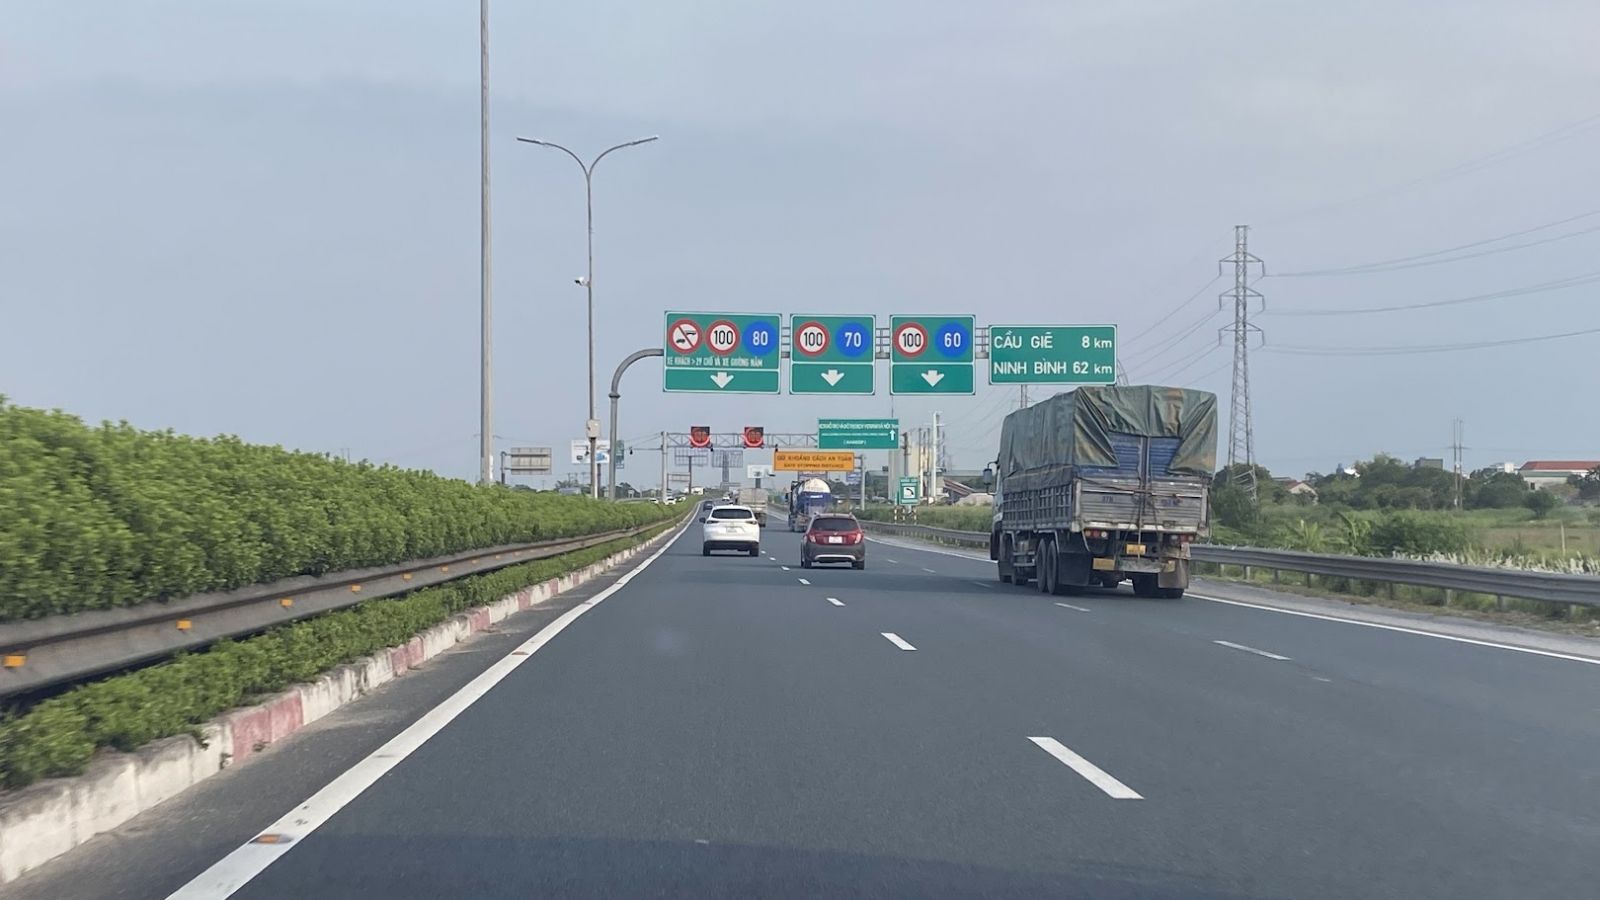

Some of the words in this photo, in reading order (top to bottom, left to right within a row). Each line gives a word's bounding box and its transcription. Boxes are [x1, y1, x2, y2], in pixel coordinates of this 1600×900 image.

[714, 330, 733, 345] 100
[752, 331, 768, 346] 80
[803, 332, 822, 347] 100
[844, 332, 861, 347] 70
[902, 332, 921, 348] 100
[944, 332, 961, 347] 60
[993, 330, 1022, 349] CẦU
[1081, 335, 1090, 348] 8
[1094, 337, 1112, 348] km
[993, 361, 1027, 375] NINH
[1034, 358, 1066, 375] BÌNH
[1072, 361, 1088, 374] 62
[1094, 363, 1112, 374] km
